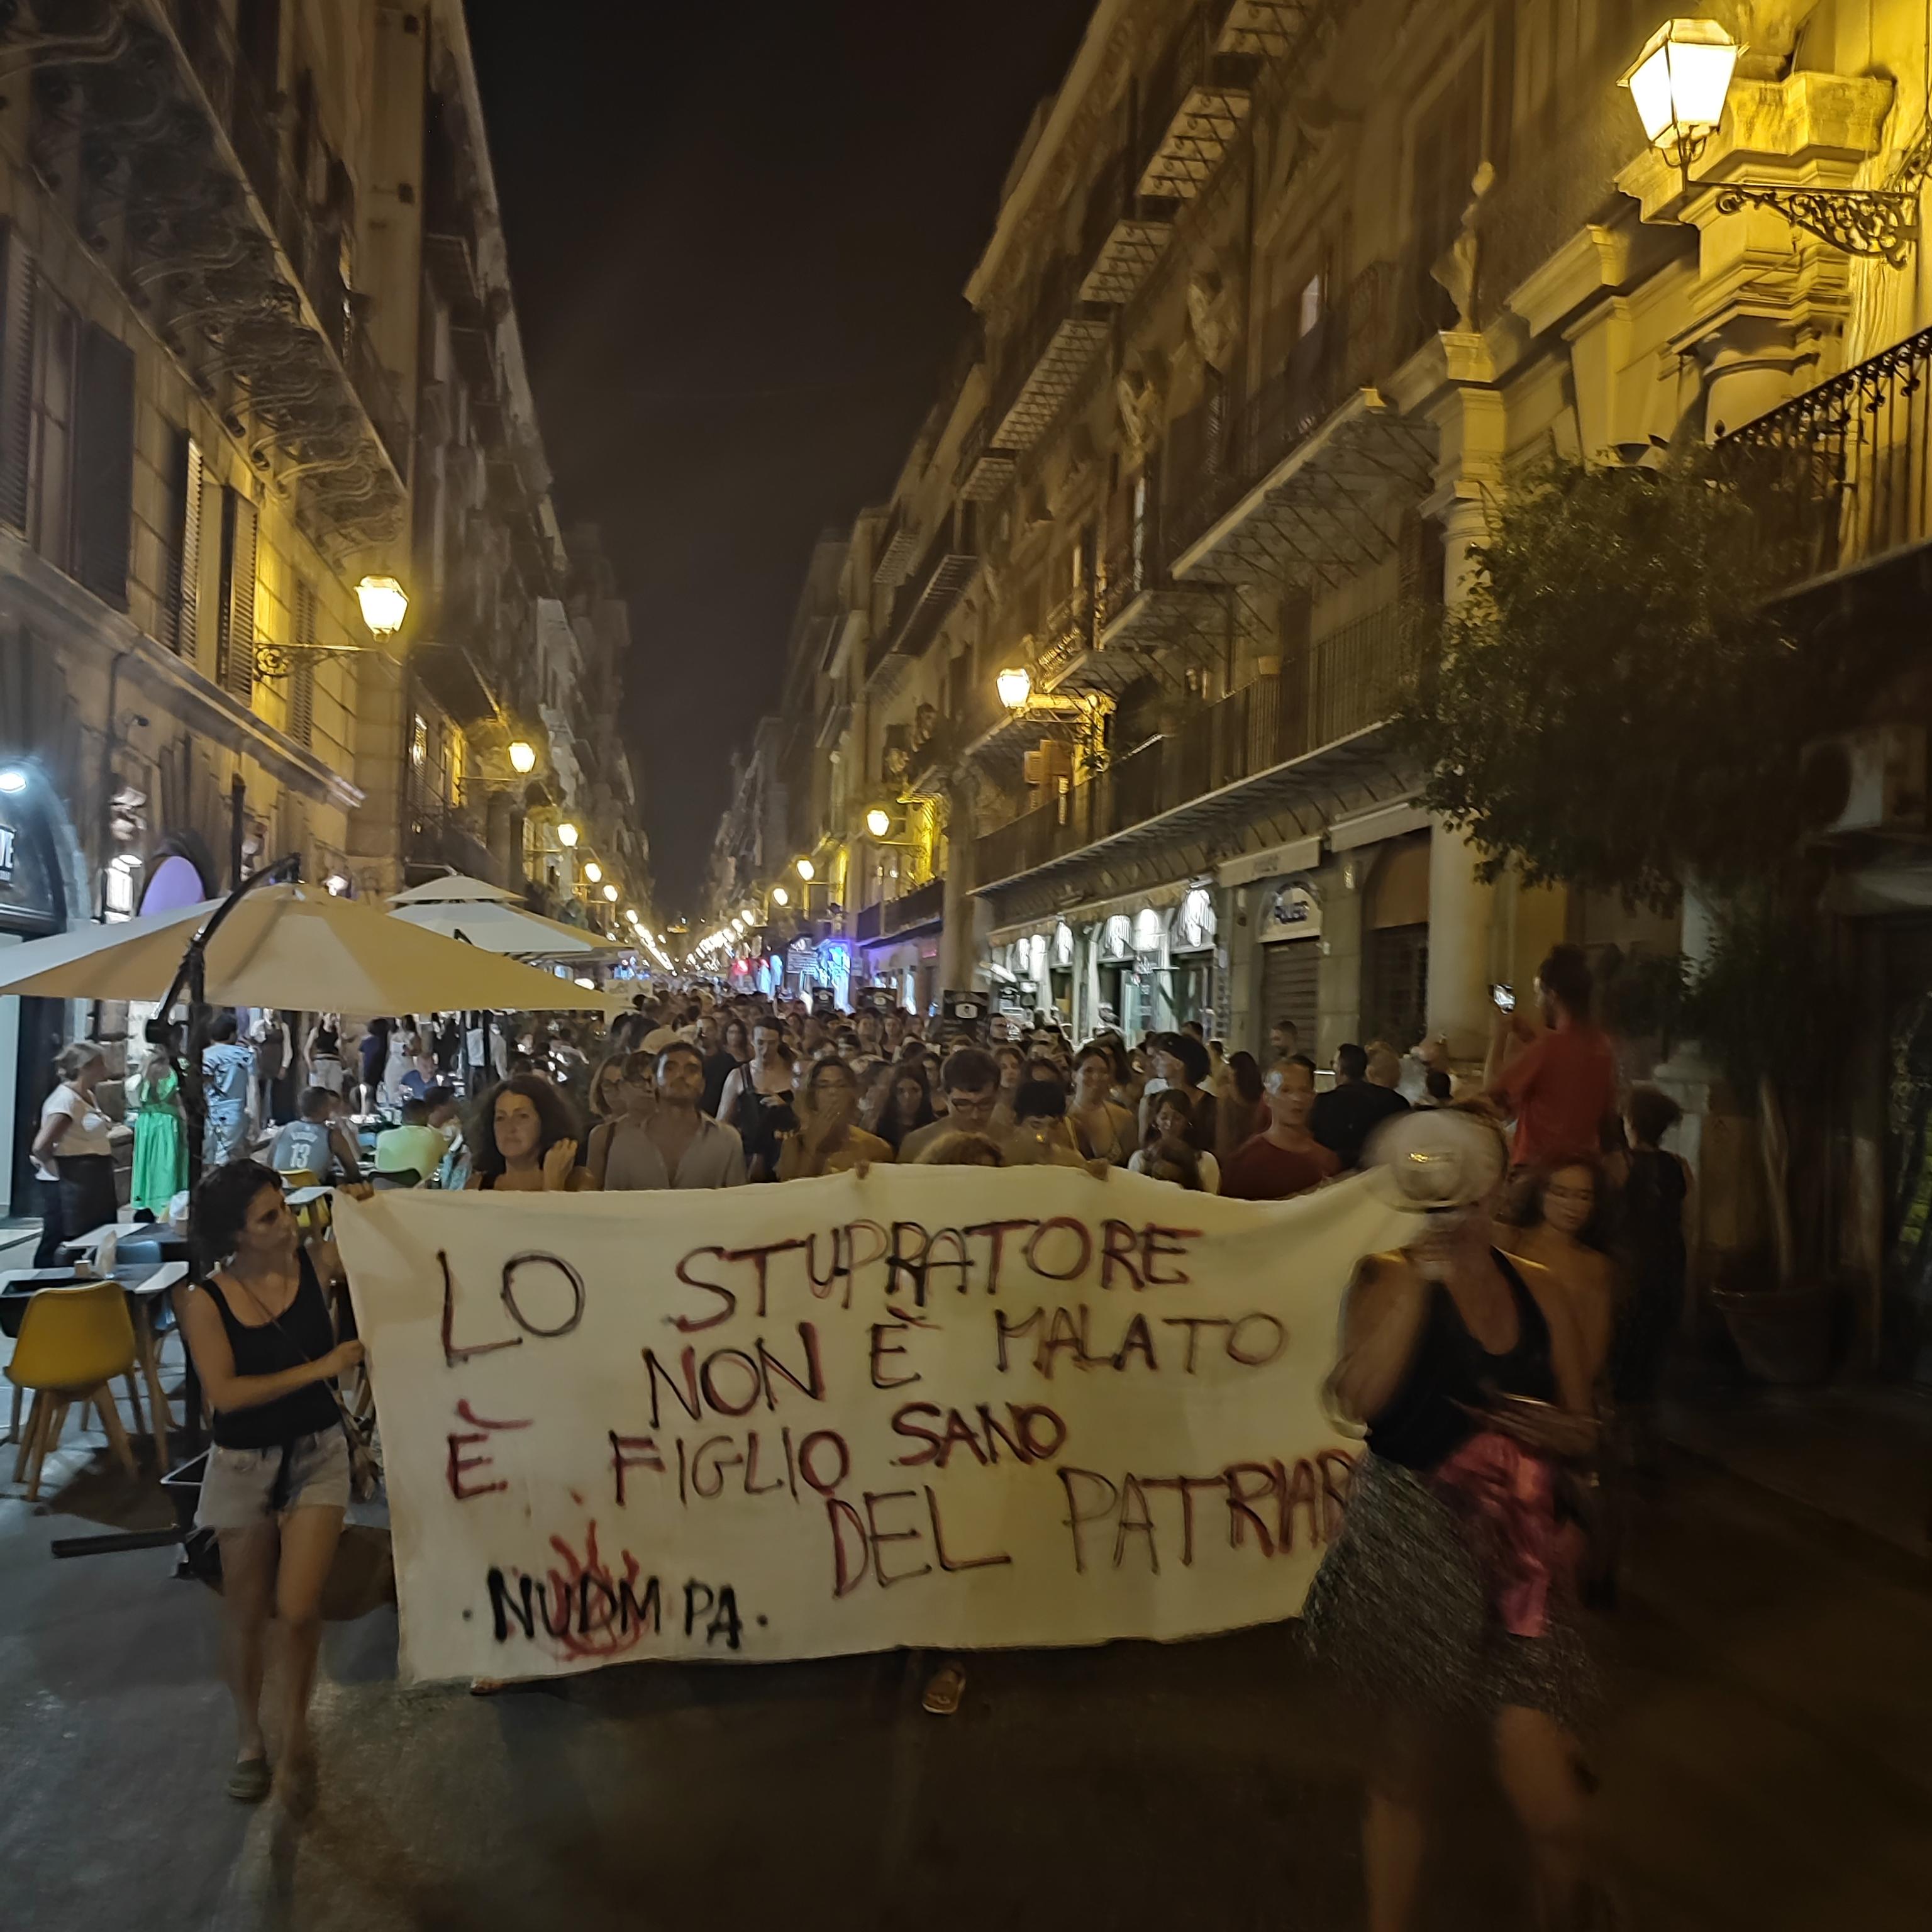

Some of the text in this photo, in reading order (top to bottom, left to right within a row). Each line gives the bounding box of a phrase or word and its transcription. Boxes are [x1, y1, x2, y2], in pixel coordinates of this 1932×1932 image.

[291, 1143, 311, 1169] 13
[437, 1215, 1202, 1367] LO STUPRATORE
[642, 1321, 826, 1429] NON
[992, 1302, 1289, 1380] MALATO
[608, 1426, 850, 1507] FIGLIO
[890, 1401, 1067, 1469] SANO
[826, 1448, 1357, 1599] DEL PATRIAR
